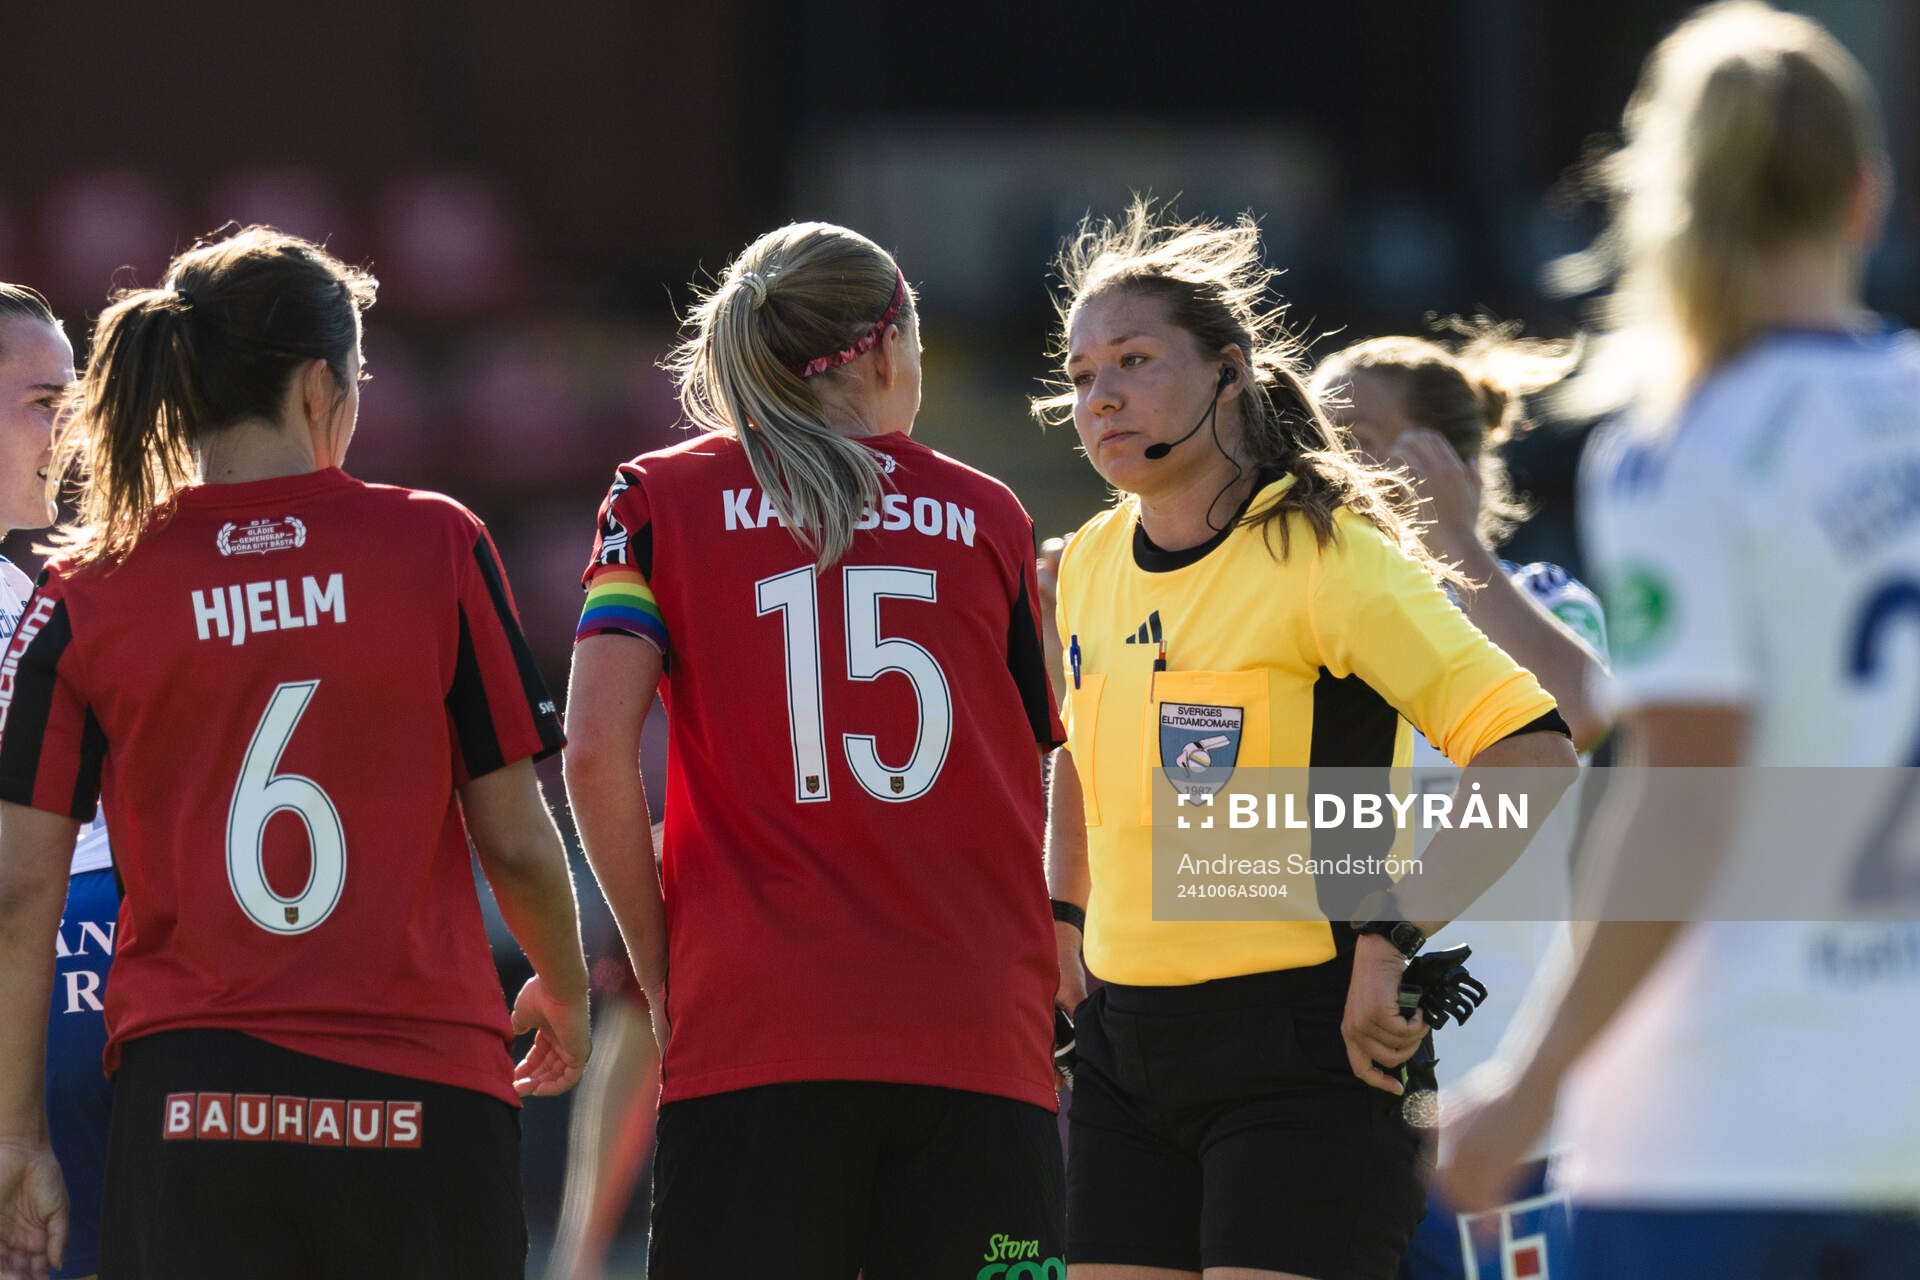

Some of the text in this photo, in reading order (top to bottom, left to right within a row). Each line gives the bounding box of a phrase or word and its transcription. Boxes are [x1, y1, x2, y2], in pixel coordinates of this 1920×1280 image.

[722, 487, 976, 548] KASSON
[192, 573, 347, 646] HJELM
[755, 564, 953, 803] 15
[1161, 715, 1240, 729] ELITDAMDOMARE
[1177, 706, 1222, 718] SVERIGES
[226, 679, 347, 936] 6
[168, 1100, 418, 1142] BAUHAUS
[983, 1233, 1040, 1262] Stora
